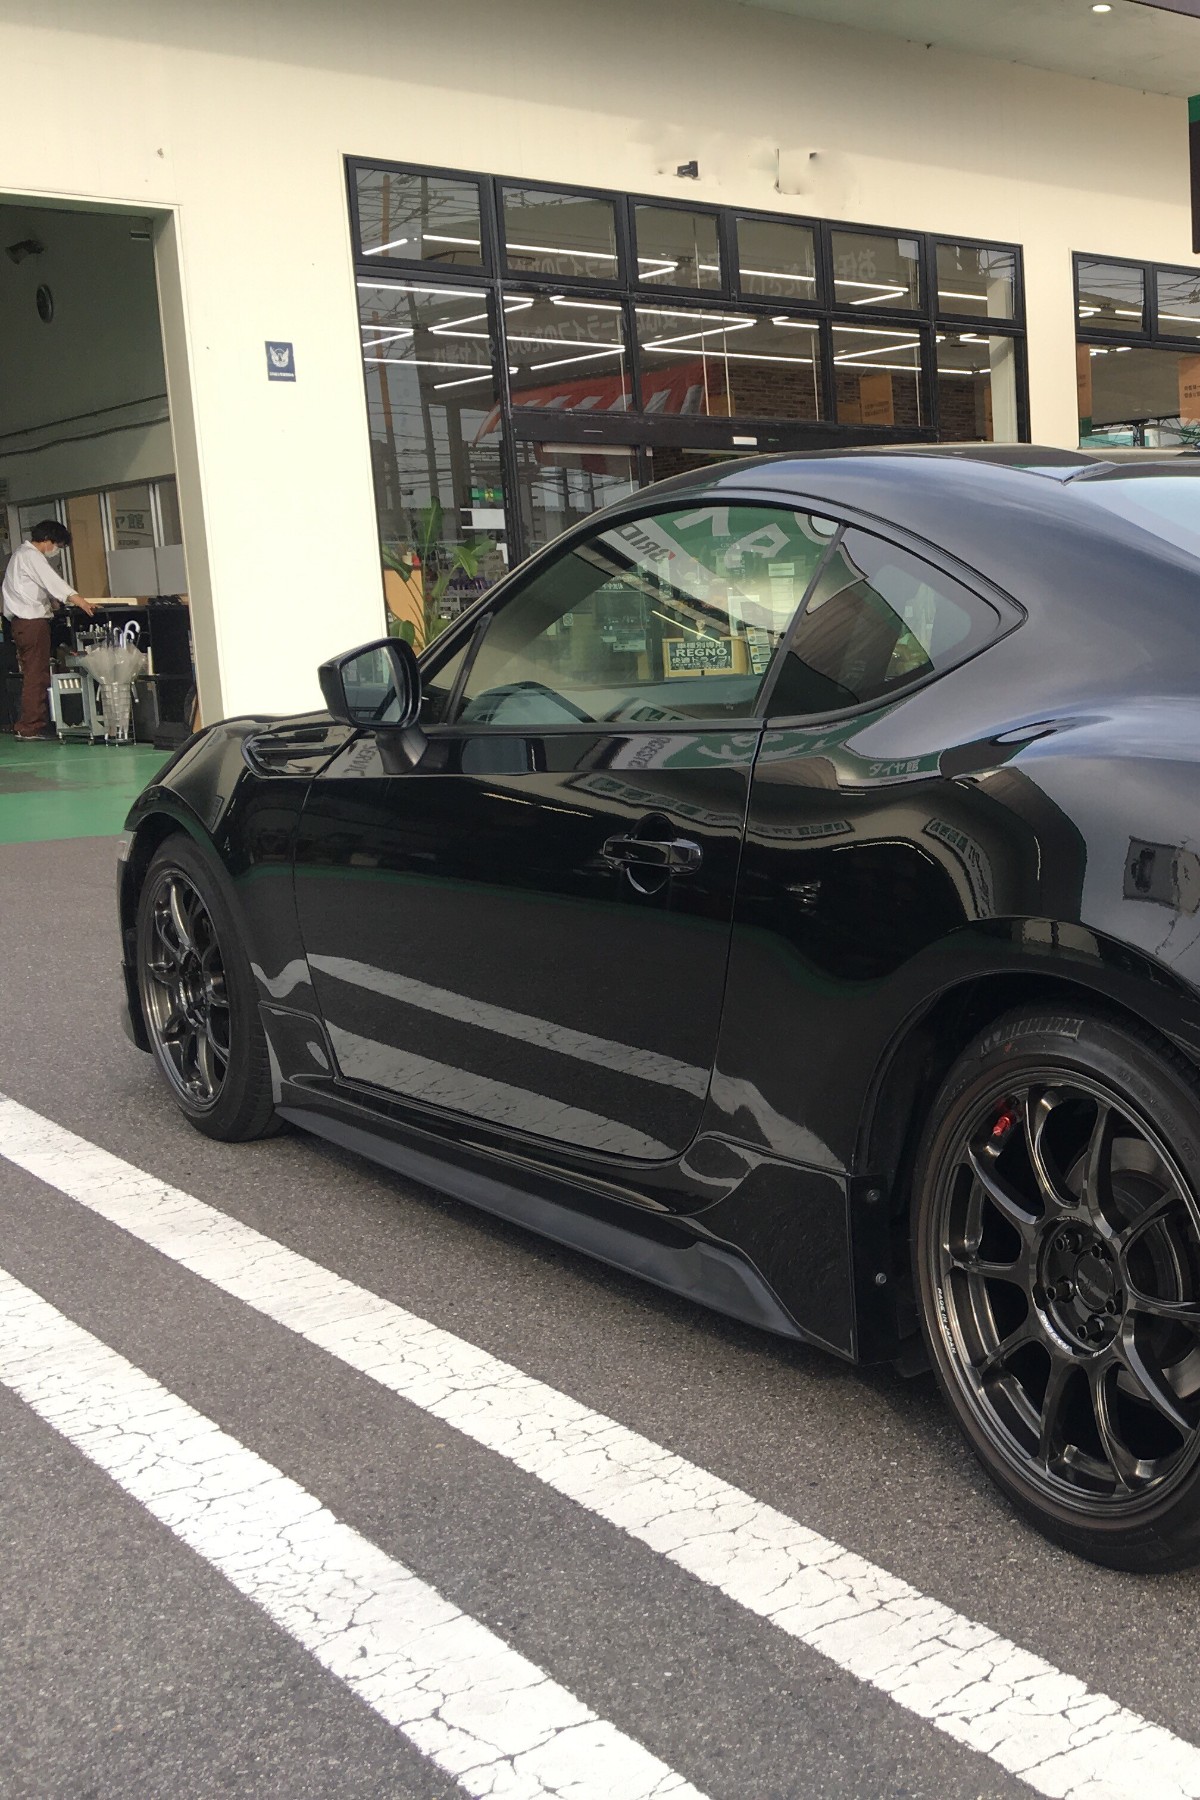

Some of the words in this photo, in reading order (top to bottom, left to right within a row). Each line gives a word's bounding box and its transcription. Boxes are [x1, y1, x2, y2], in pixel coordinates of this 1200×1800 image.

[675, 647, 728, 657] REGNO
[937, 1287, 946, 1312] MADE
[944, 1325, 957, 1354] JAPAN
